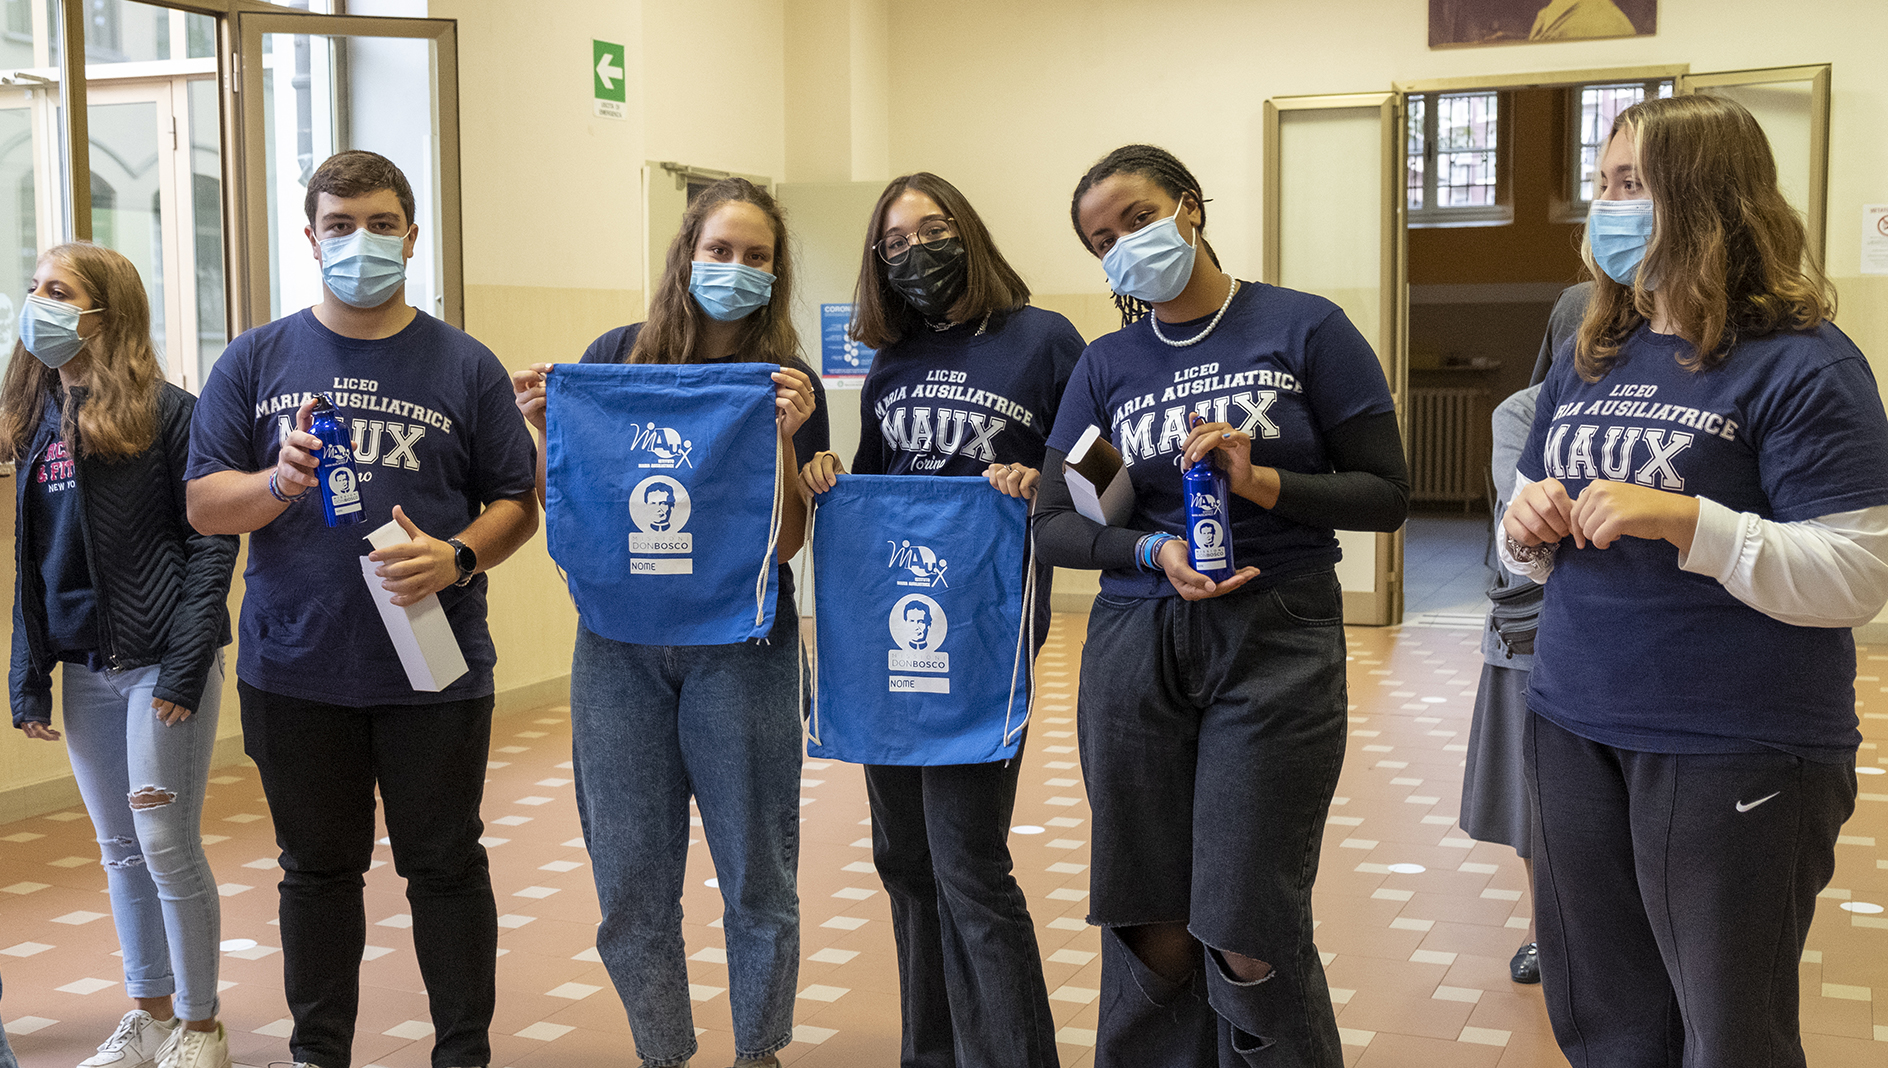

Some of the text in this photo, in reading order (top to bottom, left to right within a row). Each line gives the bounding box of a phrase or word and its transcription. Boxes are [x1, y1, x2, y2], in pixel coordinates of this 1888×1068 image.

[926, 369, 967, 384] LICEO
[1174, 362, 1219, 383] LICEO
[333, 377, 379, 393] LICEO
[1161, 369, 1303, 402] AUSILIATRICE
[1609, 384, 1658, 398] LICEO
[875, 384, 1034, 428] MARIA AUSILIATRICE
[1552, 400, 1739, 442] RIA AUSILIATRICE
[880, 406, 1007, 464] MAUX
[910, 453, 947, 472] Torino
[48, 480, 76, 493] NEW YO
[631, 562, 656, 571] NOME
[890, 679, 915, 688] NOME
